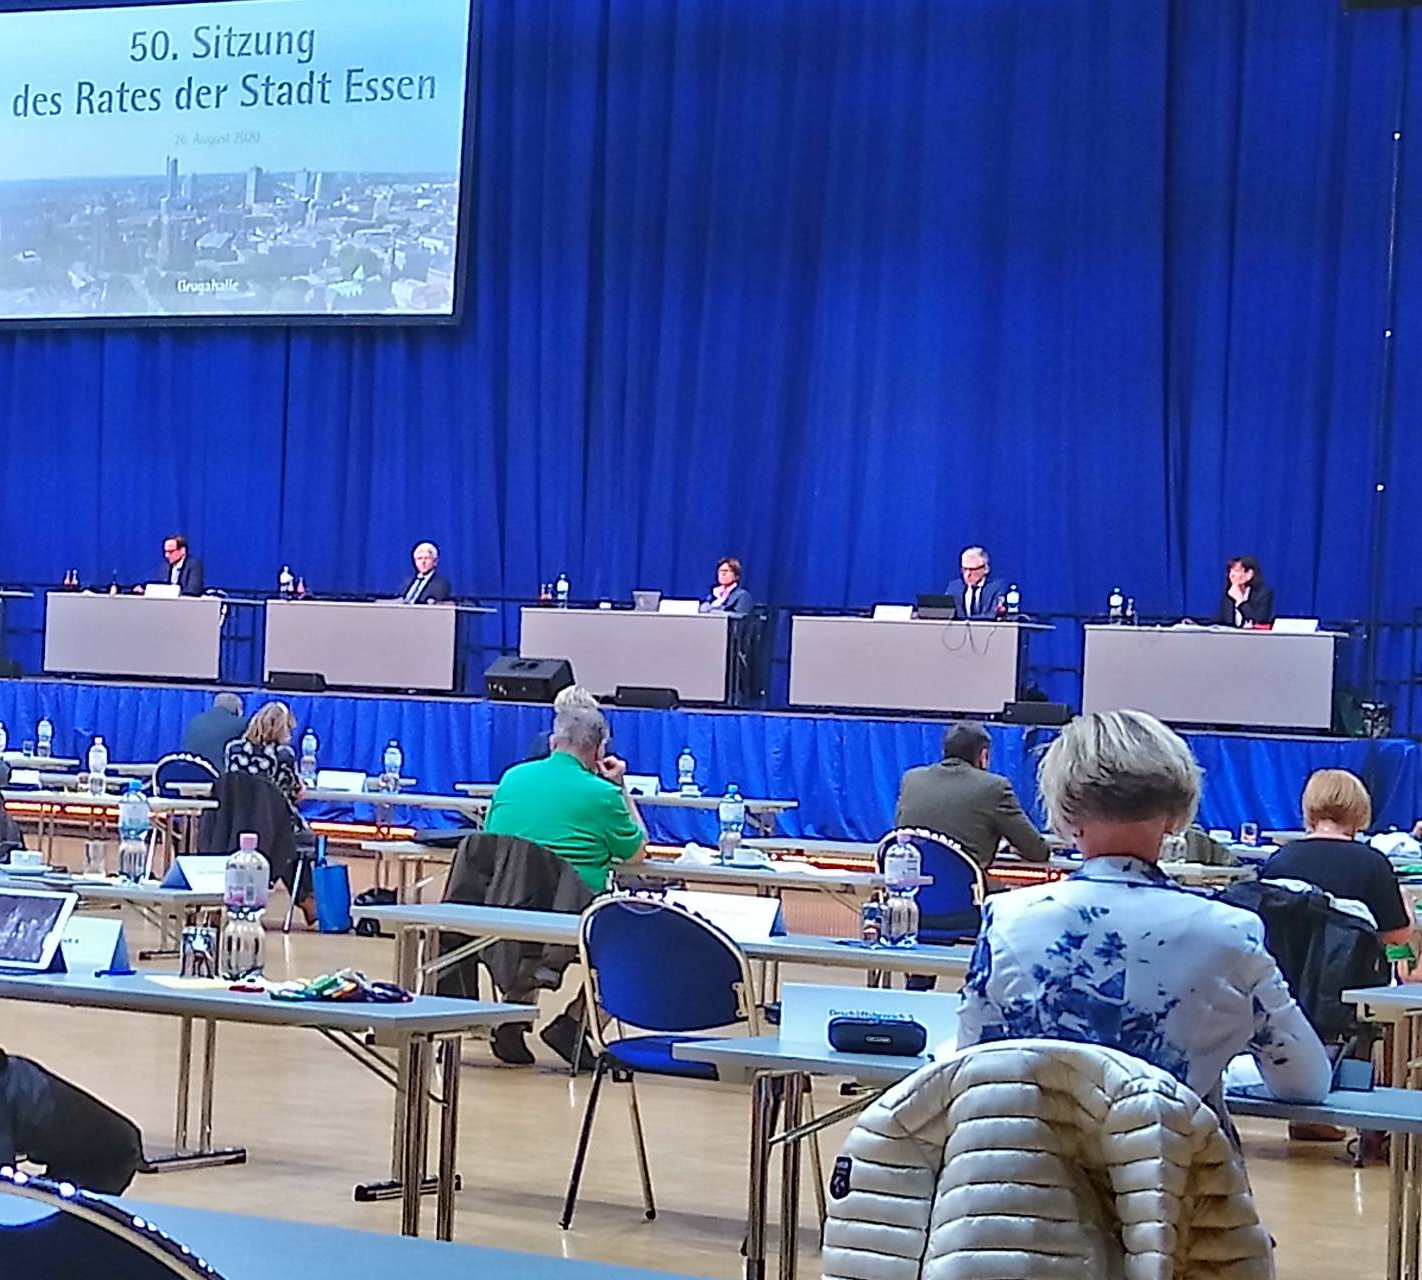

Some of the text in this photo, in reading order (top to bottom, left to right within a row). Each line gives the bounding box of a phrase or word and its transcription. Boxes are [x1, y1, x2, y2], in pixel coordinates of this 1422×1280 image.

[130, 25, 316, 63] 50. Sitzung
[12, 68, 436, 118] des Rates der Stadt Essen
[177, 278, 239, 295] Grugahalle
